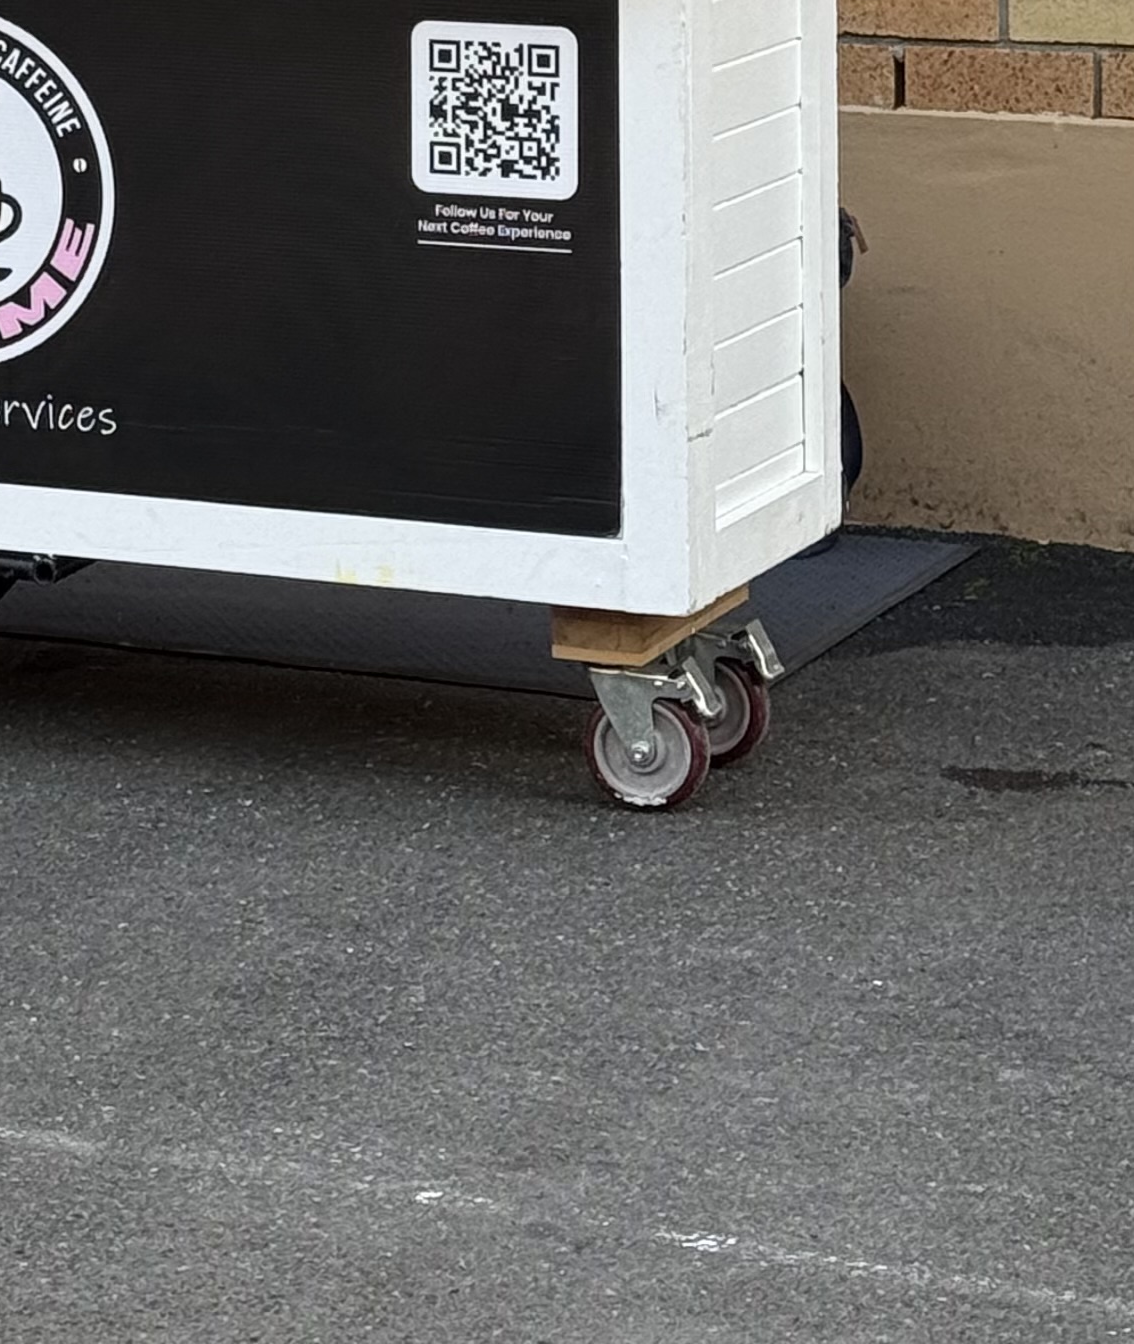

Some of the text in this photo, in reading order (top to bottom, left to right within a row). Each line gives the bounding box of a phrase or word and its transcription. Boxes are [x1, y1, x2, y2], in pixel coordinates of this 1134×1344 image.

[434, 204, 554, 224] Follow Us For Your
[417, 219, 572, 241] Next Coffee Experience
